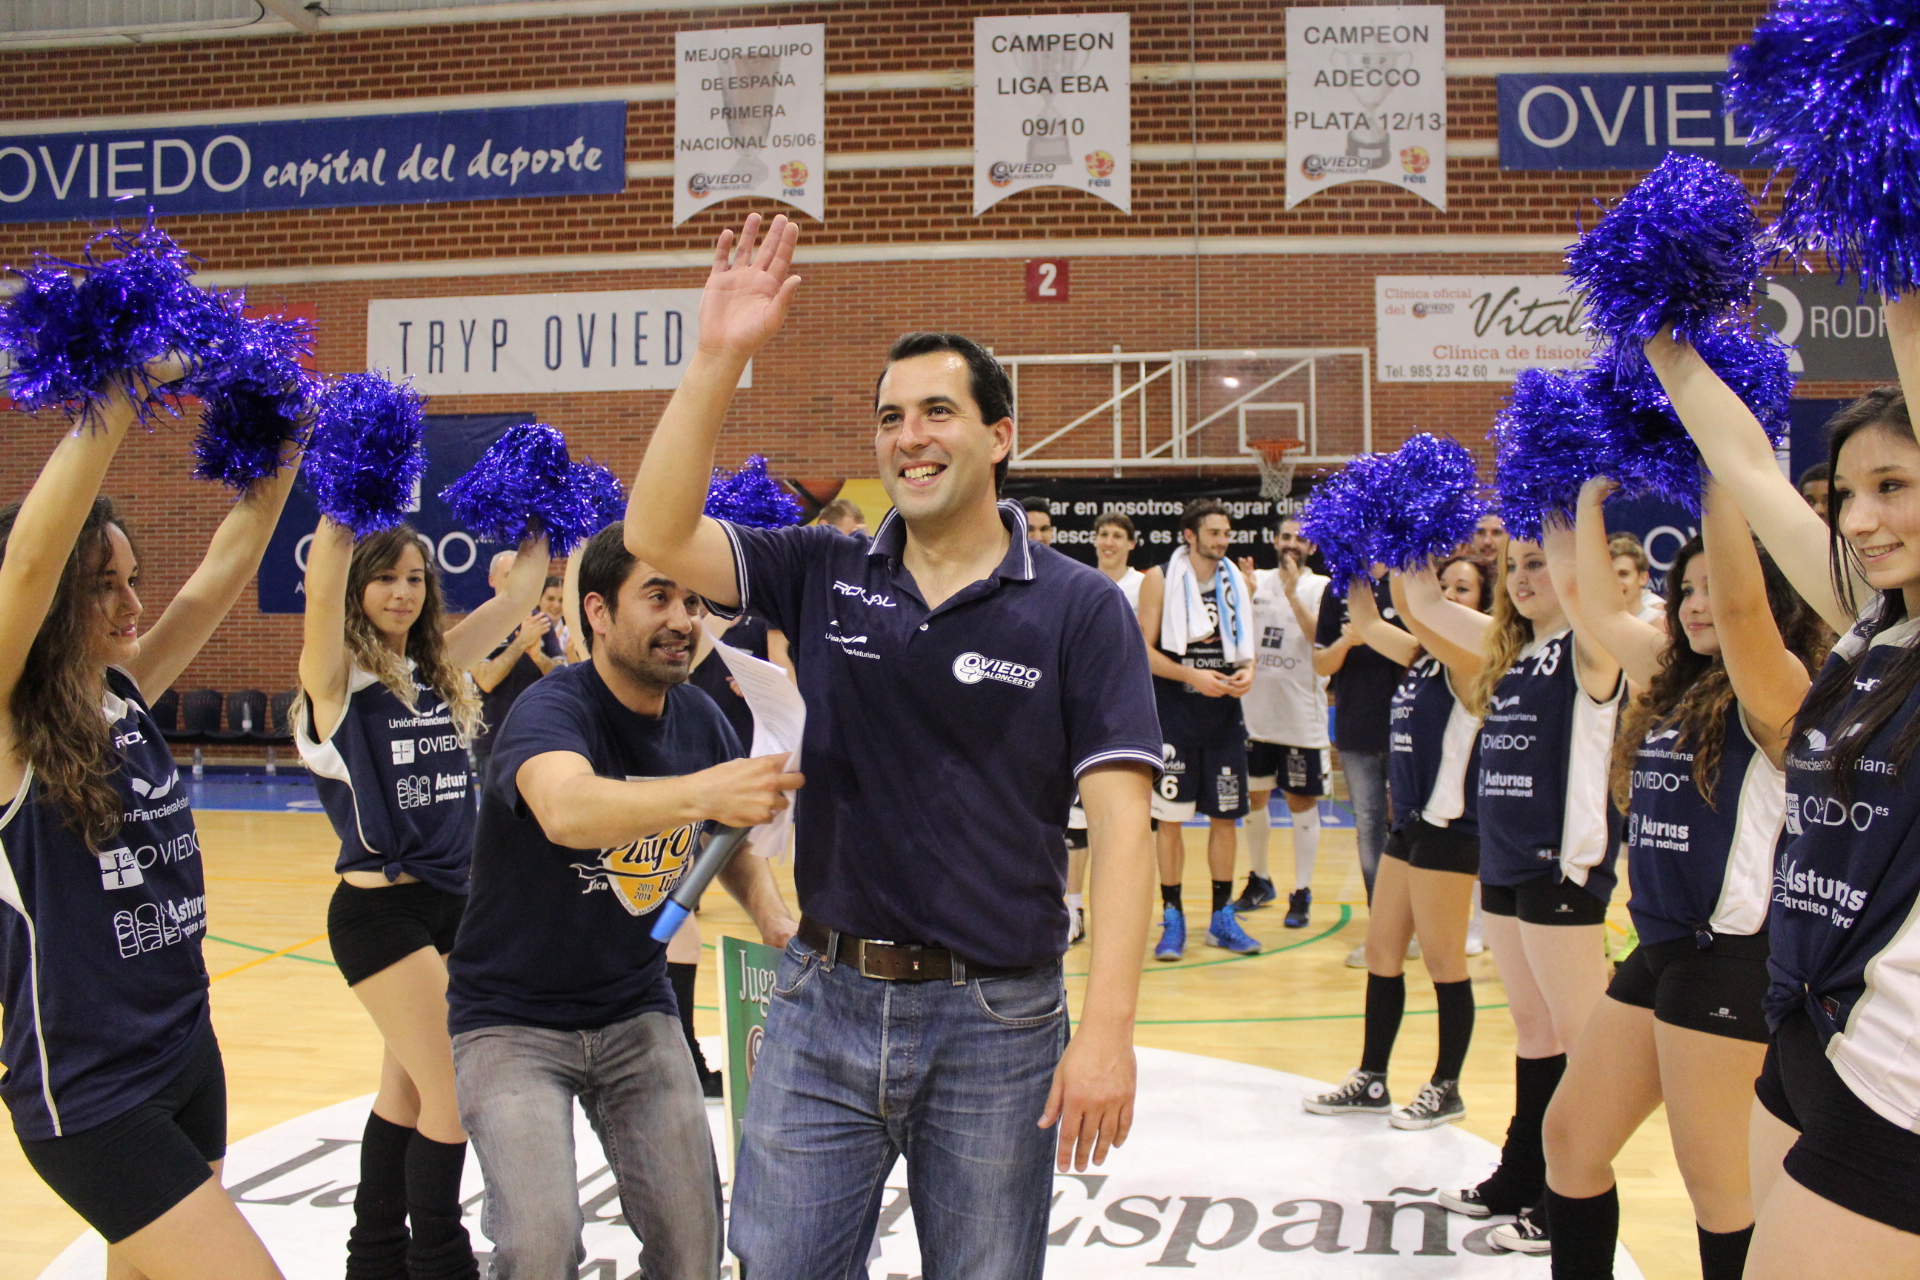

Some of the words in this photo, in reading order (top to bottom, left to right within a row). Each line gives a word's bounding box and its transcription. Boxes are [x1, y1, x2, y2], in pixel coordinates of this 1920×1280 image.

[992, 32, 1113, 52] CAMPEON
[1304, 25, 1429, 44] CAMPEON
[684, 47, 742, 62] MEJOR
[747, 42, 813, 58] EQUIPO
[701, 77, 723, 91] DE
[728, 71, 796, 90] ESPAÑA
[998, 76, 1053, 95] LIGA
[1061, 75, 1109, 93] EBA
[1314, 69, 1421, 87] ADECCO
[710, 104, 786, 120] PRIMERA
[1294, 112, 1370, 130] PLATA
[1378, 112, 1442, 130] 12/13
[1022, 118, 1084, 136] 09/10
[680, 136, 767, 151] NACIONAL
[772, 134, 816, 148] 05/06
[0, 134, 251, 203] OVIEDO
[263, 148, 386, 197] capital
[397, 143, 456, 183] del
[467, 136, 603, 186] deporte
[995, 162, 1057, 175] OVIEDO
[1308, 155, 1372, 168] OVIEDO
[694, 173, 752, 185] OVIEDO
[1038, 263, 1057, 296] 2
[1433, 288, 1472, 299] oficial
[1385, 303, 1406, 315] del
[398, 318, 507, 375] TRYP
[1506, 345, 1530, 360] de
[1385, 365, 1406, 378] Tel.
[1410, 364, 1433, 378] 985
[1437, 365, 1450, 378] 23
[1455, 364, 1469, 378] 42
[1473, 364, 1488, 378] 60
[1074, 501, 1098, 515] en
[1103, 498, 1184, 516] nosotros
[1149, 530, 1172, 544] es
[964, 656, 1042, 681] OVIEDO
[978, 669, 1035, 688] BALONCESTO
[1160, 774, 1179, 800] 6
[633, 890, 652, 901] 2014
[637, 883, 654, 893] 2013
